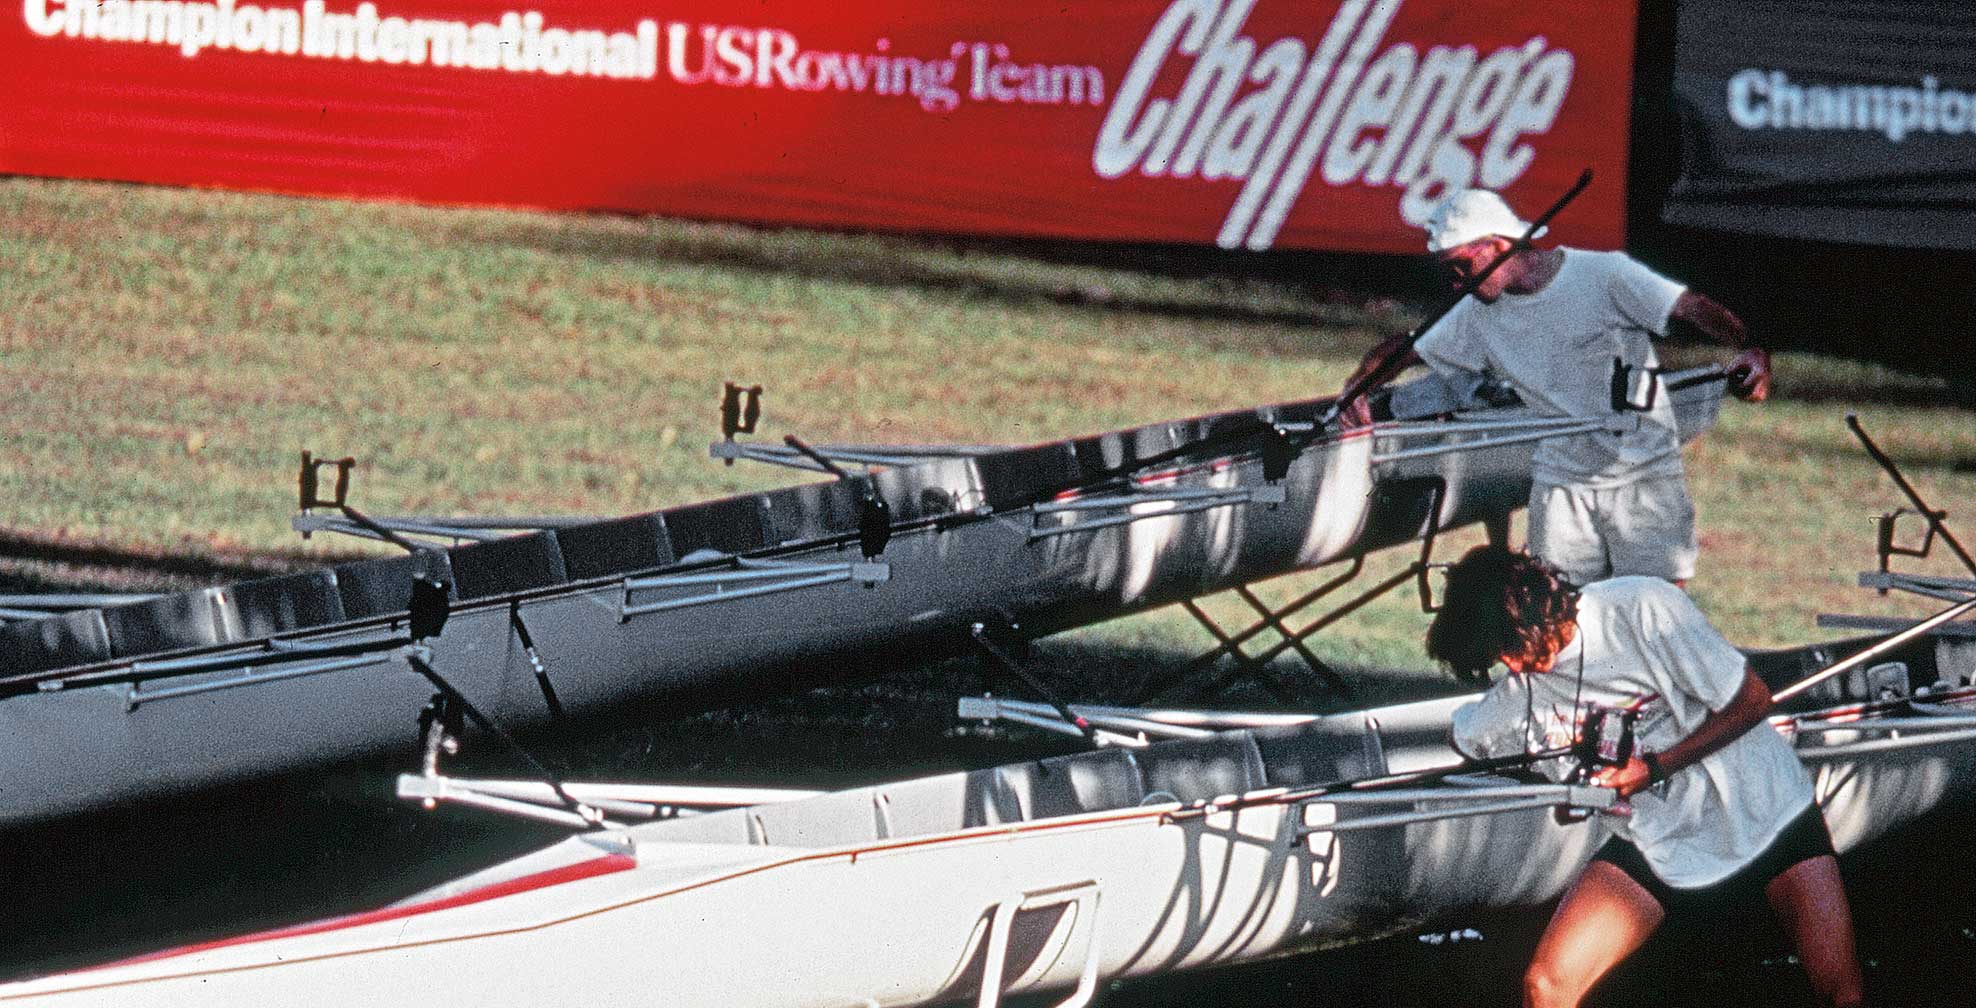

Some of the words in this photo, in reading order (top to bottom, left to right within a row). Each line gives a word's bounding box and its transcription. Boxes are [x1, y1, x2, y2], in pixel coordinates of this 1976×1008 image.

[23, 0, 301, 57] Champion
[302, 0, 658, 79] International
[950, 41, 1104, 106] Team
[1093, 0, 1574, 250] Challenge
[1728, 69, 1976, 142] Champio
